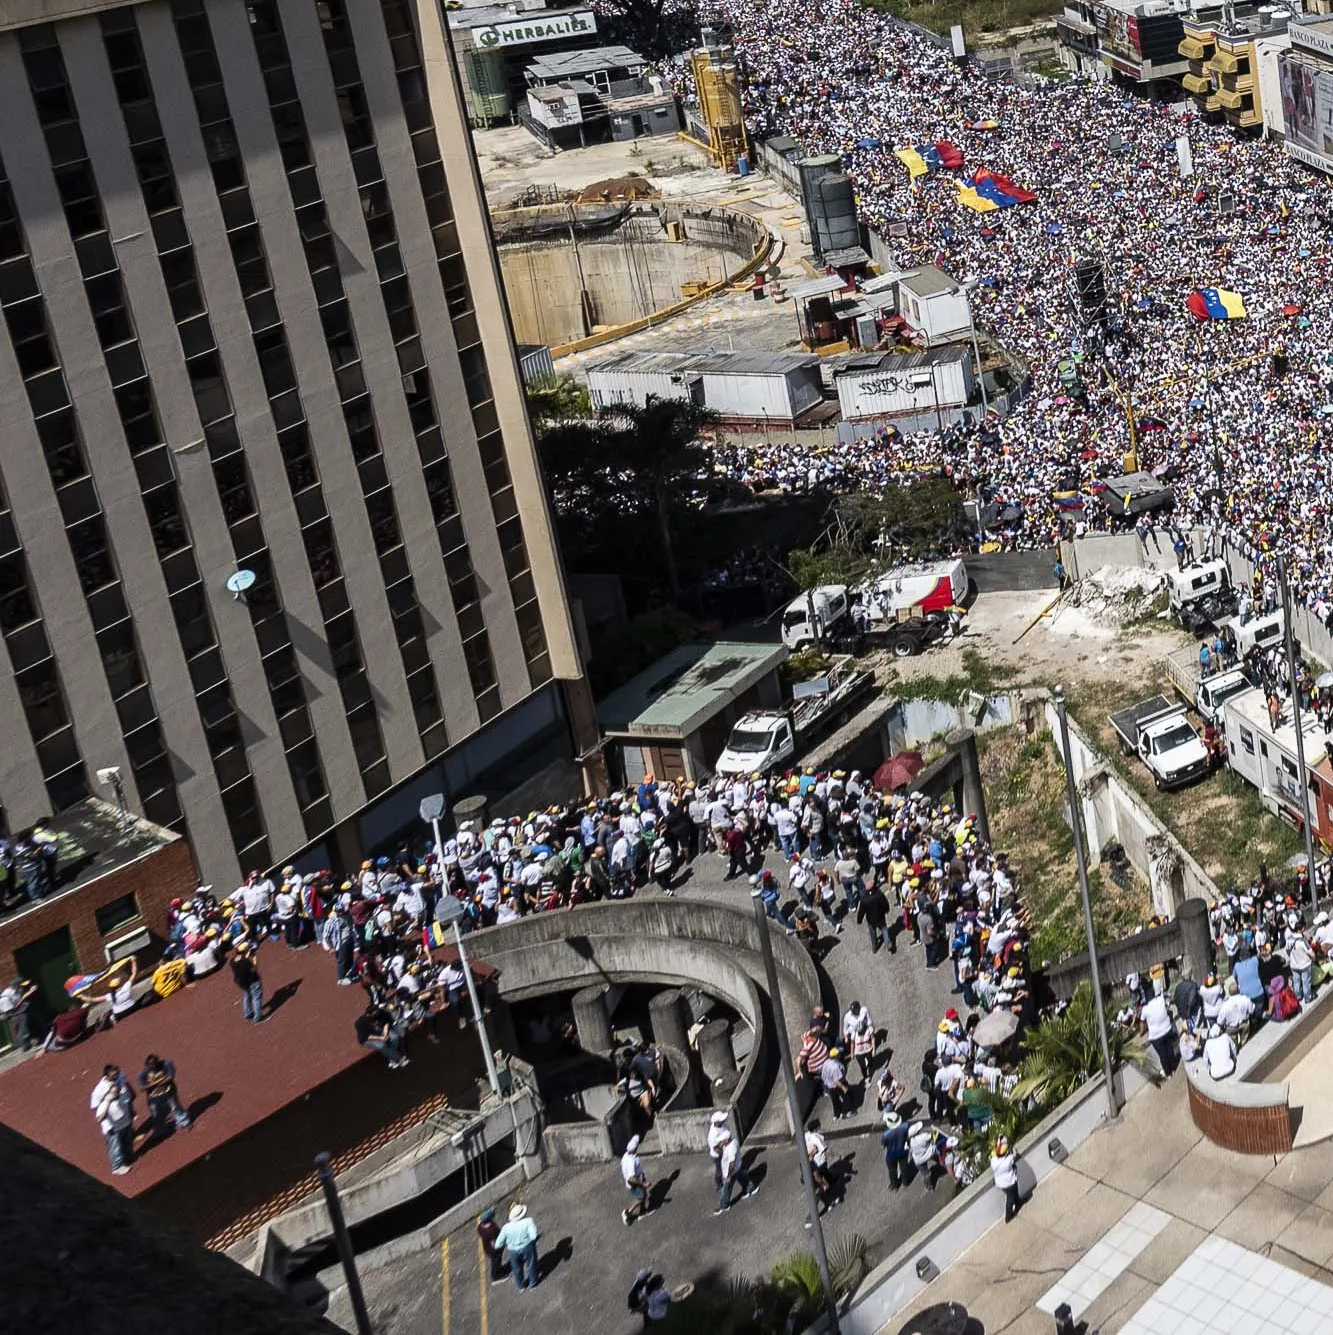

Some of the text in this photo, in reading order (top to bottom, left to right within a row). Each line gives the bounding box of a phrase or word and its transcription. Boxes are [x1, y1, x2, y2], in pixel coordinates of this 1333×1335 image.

[1289, 28, 1330, 50] BANCO PLAZA
[1286, 144, 1326, 169] BANCO PLAZA
